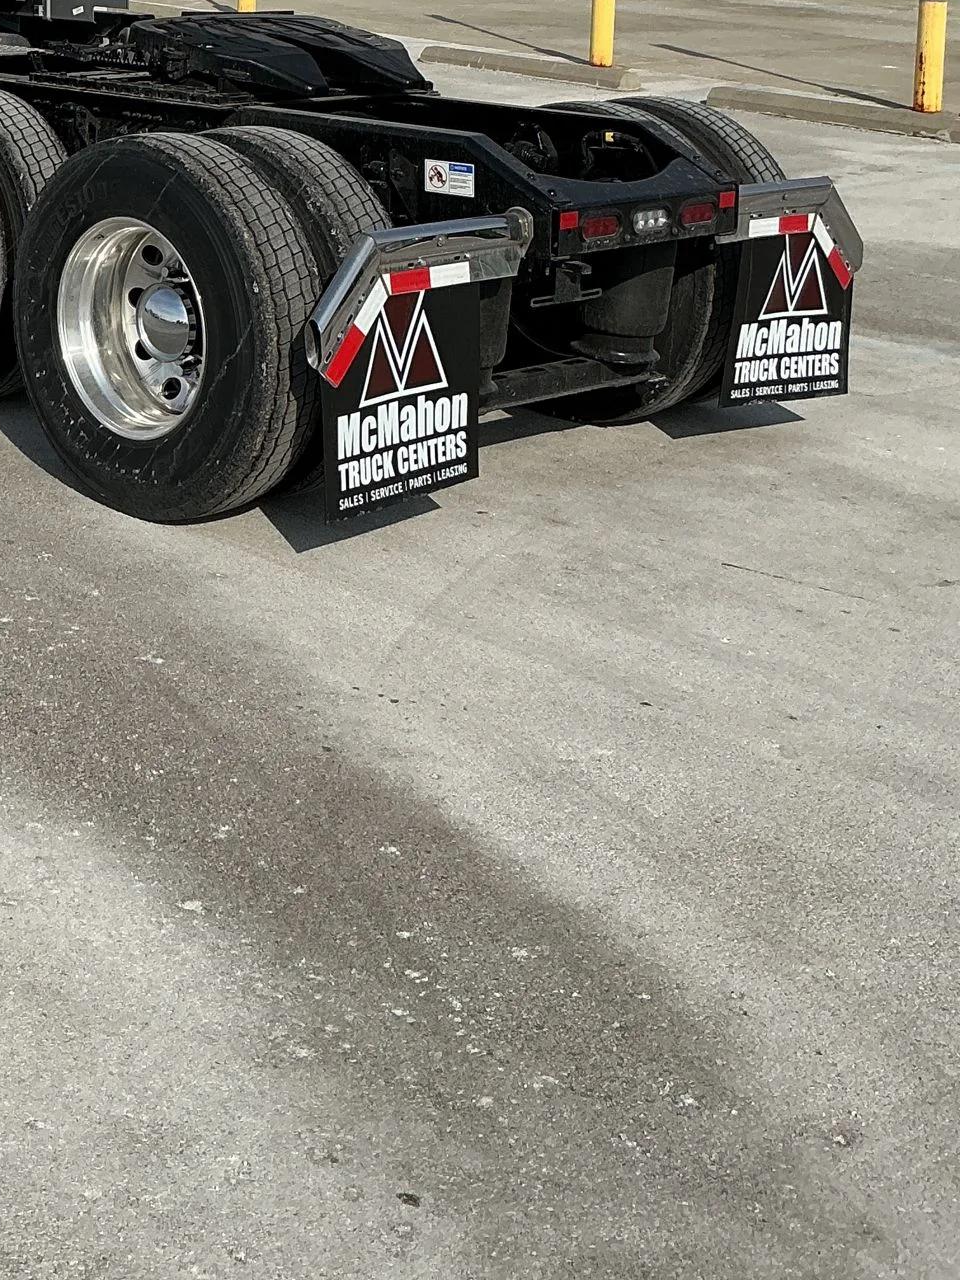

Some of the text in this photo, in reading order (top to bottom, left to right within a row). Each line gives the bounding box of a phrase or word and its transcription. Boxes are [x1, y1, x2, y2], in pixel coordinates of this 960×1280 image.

[735, 317, 842, 359] McMahon
[730, 380, 839, 399] SALES SERVICE PARTS LEASING
[733, 352, 840, 385] TRUCK CENTERS
[337, 392, 468, 461] McMahon
[338, 430, 467, 492] TRUCK CENTERS
[339, 462, 468, 511] SALES SERVICE PARTS LEASING
